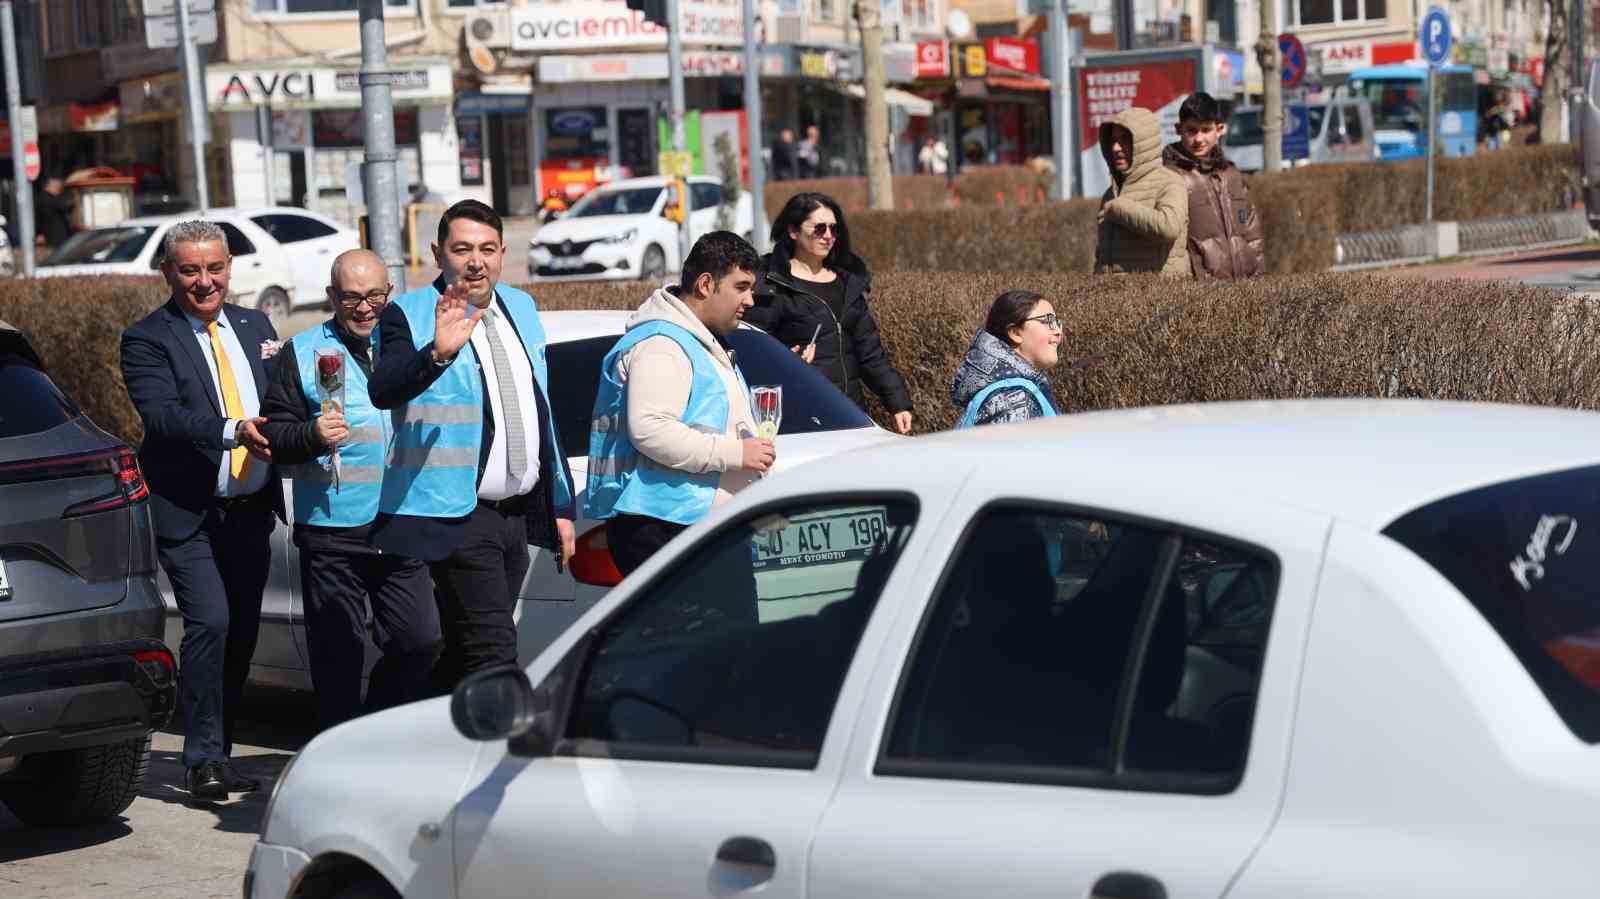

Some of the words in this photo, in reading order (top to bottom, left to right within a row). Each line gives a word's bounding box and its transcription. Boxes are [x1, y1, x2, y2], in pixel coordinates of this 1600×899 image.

[1430, 20, 1442, 40] P
[219, 73, 314, 98] AVCI
[798, 522, 831, 551] ACY
